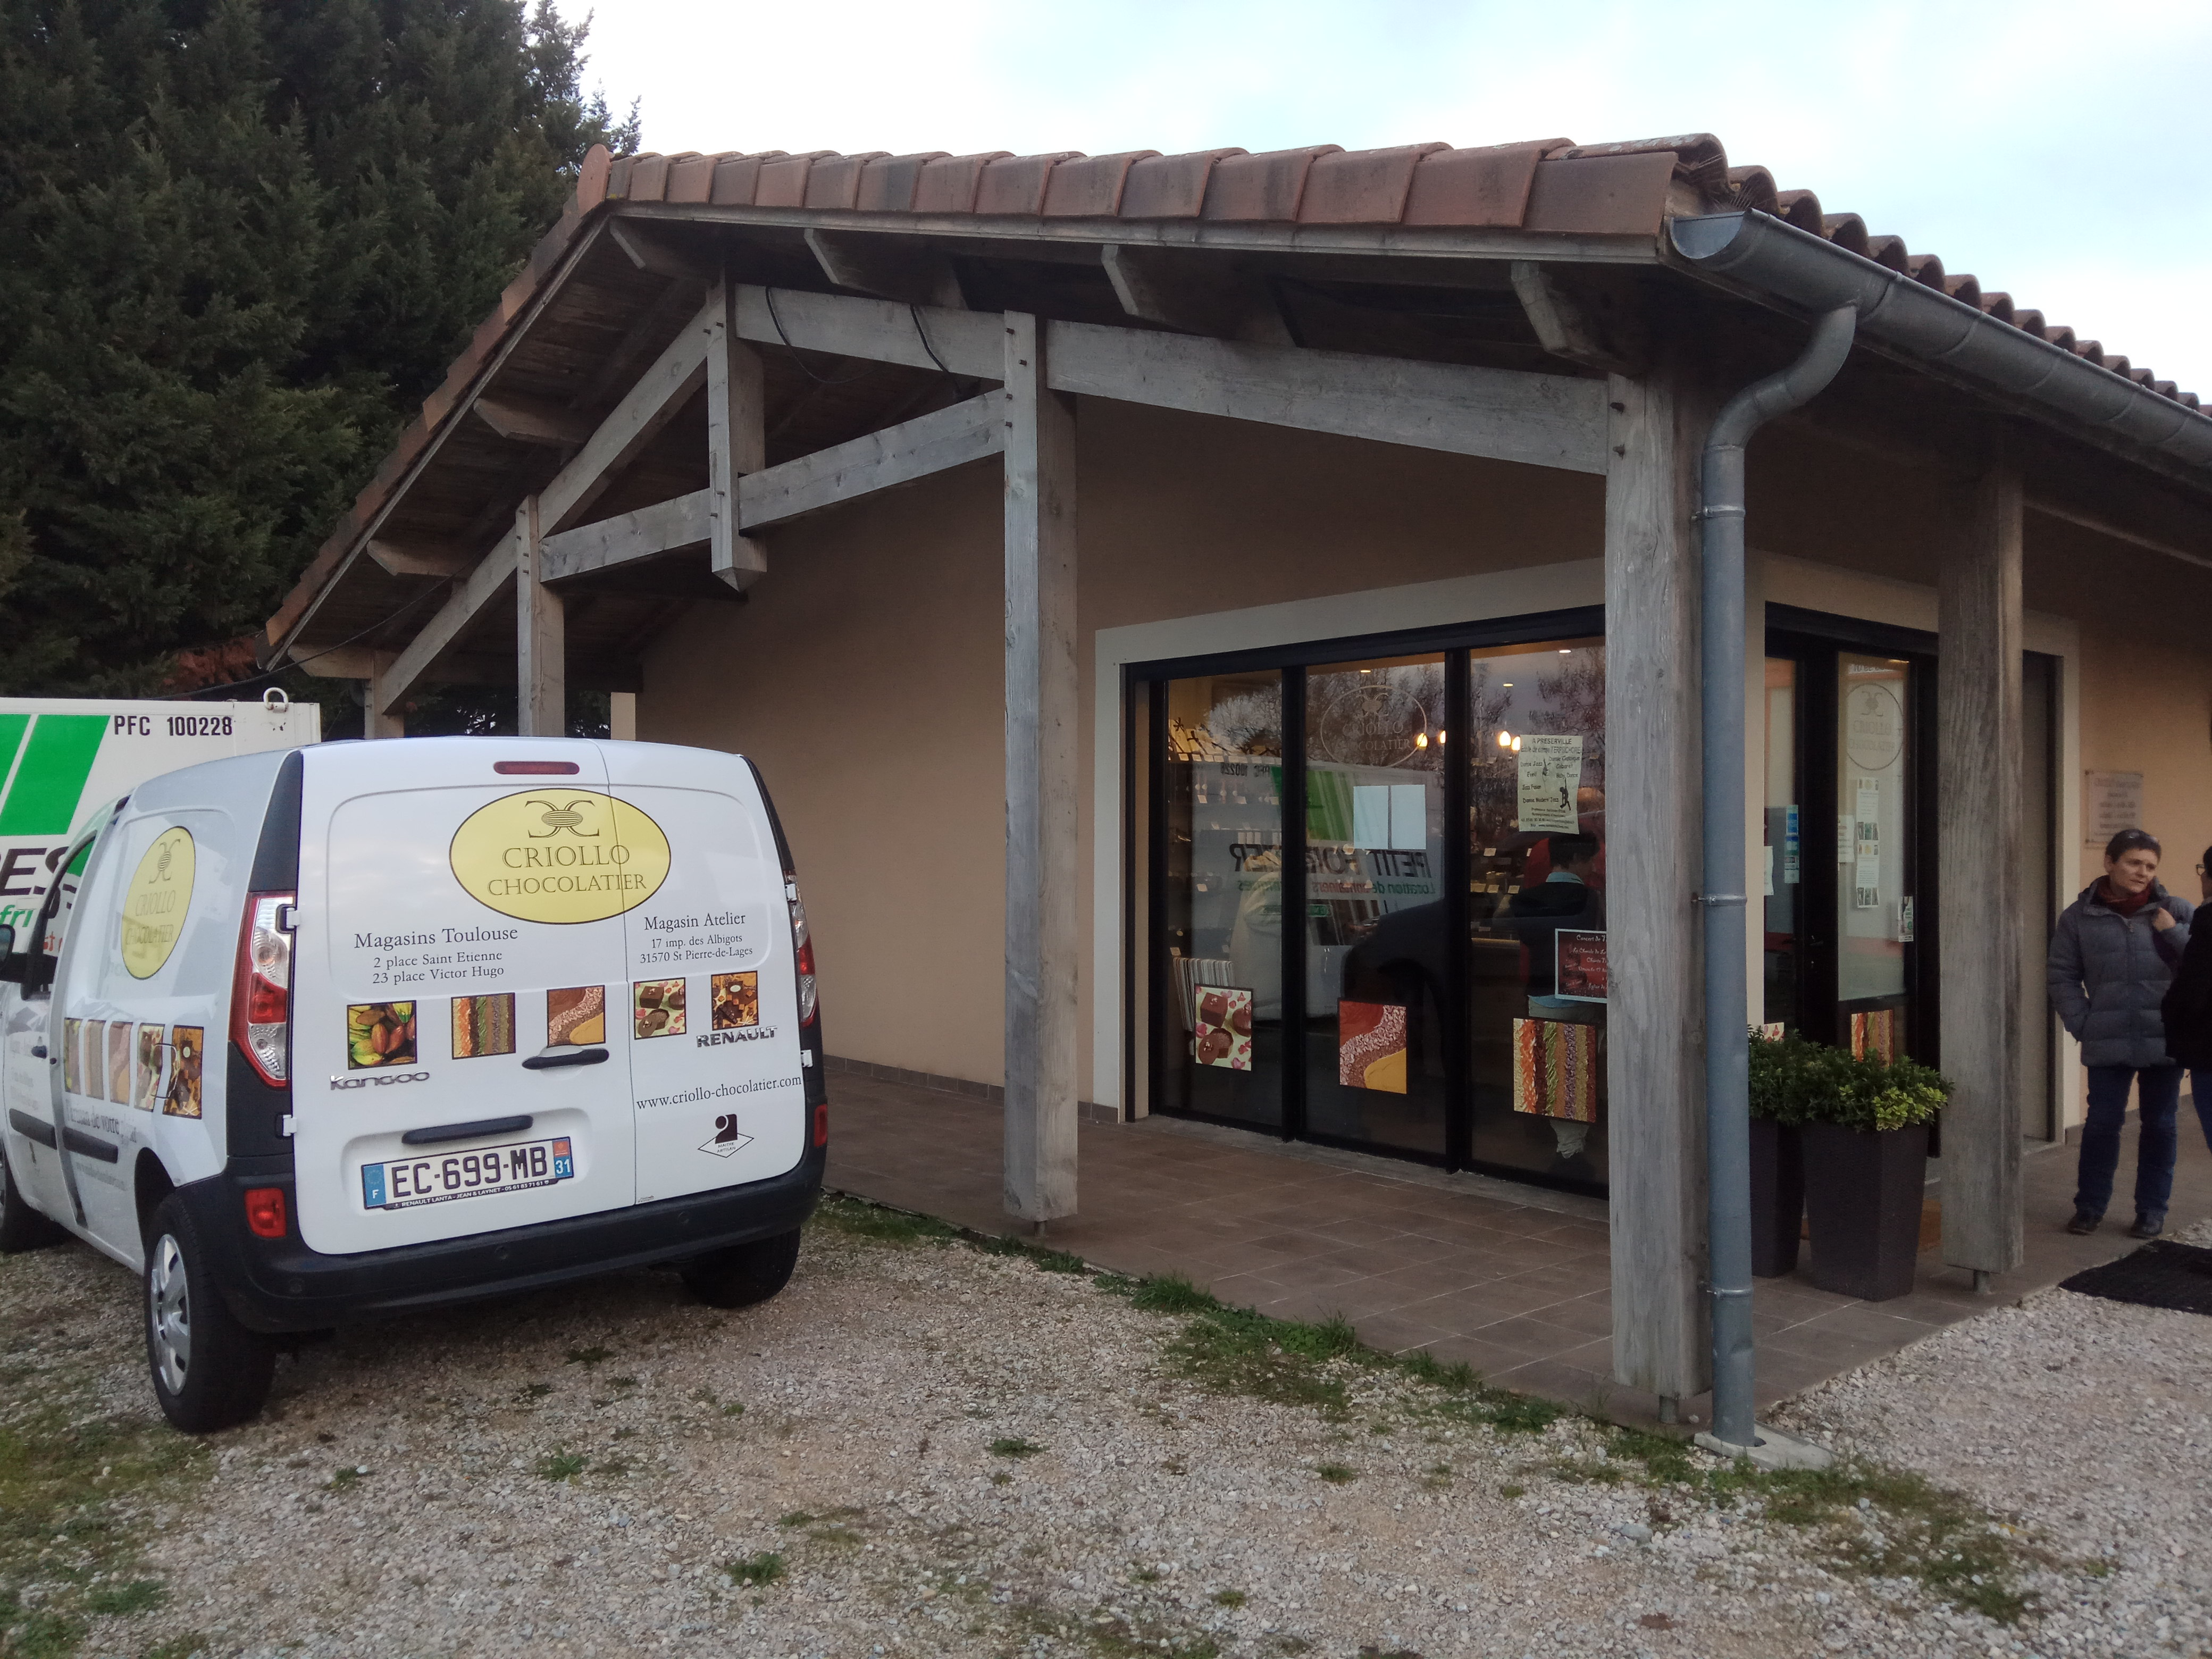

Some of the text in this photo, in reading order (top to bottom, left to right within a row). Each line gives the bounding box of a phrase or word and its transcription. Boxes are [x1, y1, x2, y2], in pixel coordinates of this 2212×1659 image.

[114, 715, 232, 736] PFC 100228
[502, 844, 630, 868] CRIOLLO
[487, 874, 647, 895] CHOCOLATIER
[136, 890, 175, 916] CRIOLLO
[644, 911, 745, 933] Magasin Atelier
[354, 926, 518, 951] Magasins Toulouse
[652, 934, 742, 949] 17 imp. des Albigots
[374, 952, 502, 970] 2 place Saint Etienne
[640, 946, 753, 963] 31570 St Pierre-de-Lages
[373, 966, 504, 985] 23 place Victor Hugo
[696, 1026, 777, 1048] RENAULT
[636, 1076, 802, 1109] www.criollo-chocolatier.com
[372, 1146, 571, 1199] F EC-699-MB 31
